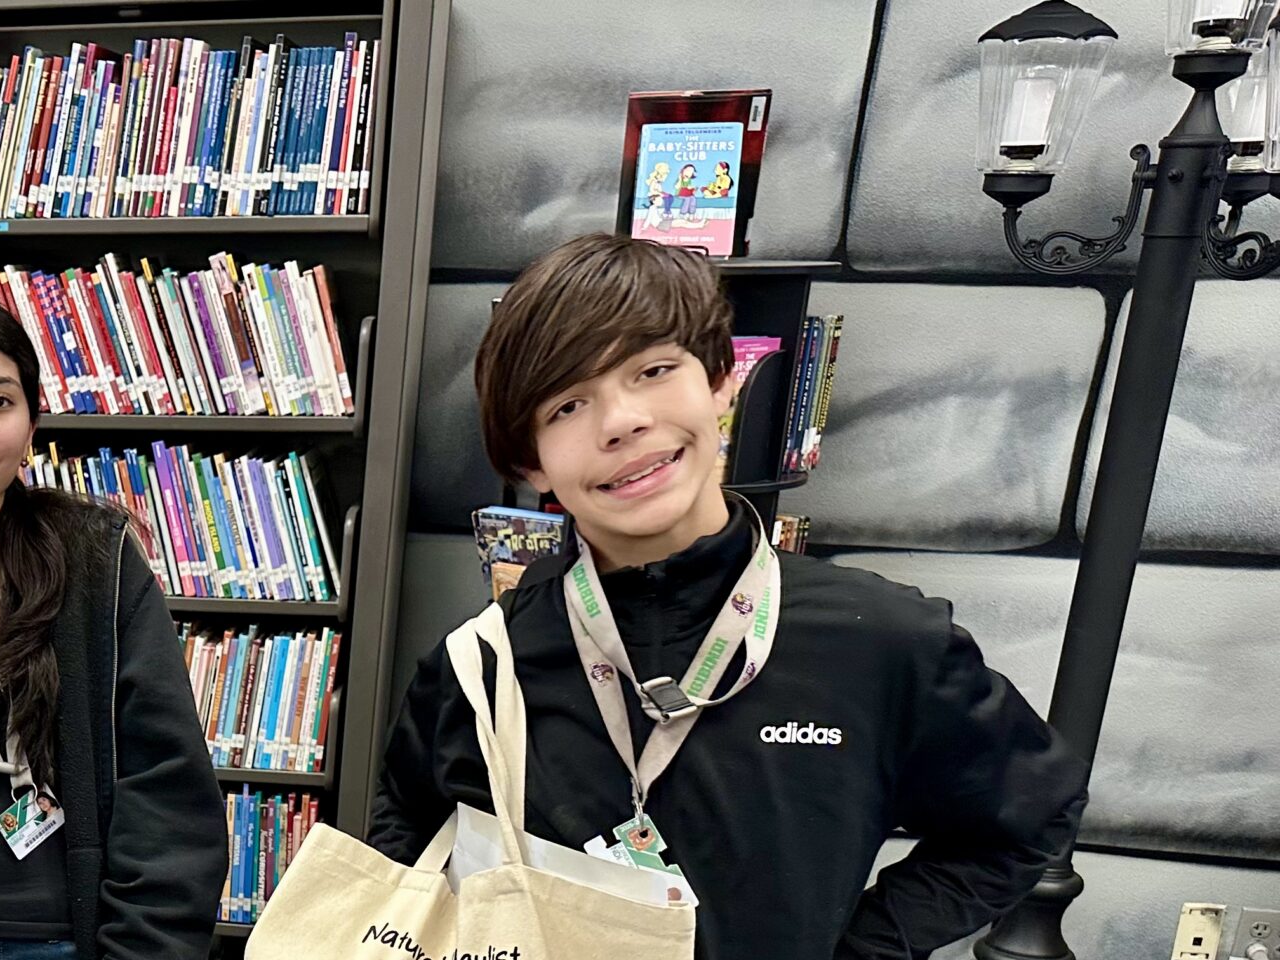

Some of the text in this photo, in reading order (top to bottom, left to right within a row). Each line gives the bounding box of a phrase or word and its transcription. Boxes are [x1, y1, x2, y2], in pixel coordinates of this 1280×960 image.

[648, 141, 736, 152] BABY-SITTERS
[674, 151, 707, 161] CLUB
[115, 302, 131, 343] WOUNDED
[202, 498, 220, 552] RHODE ISLAND
[224, 499, 242, 546] CONNECTICUT
[572, 563, 601, 618] ISIBINDI
[686, 636, 728, 698] ISIBINDI
[759, 722, 842, 744] adidas
[232, 834, 240, 865] MONTANA
